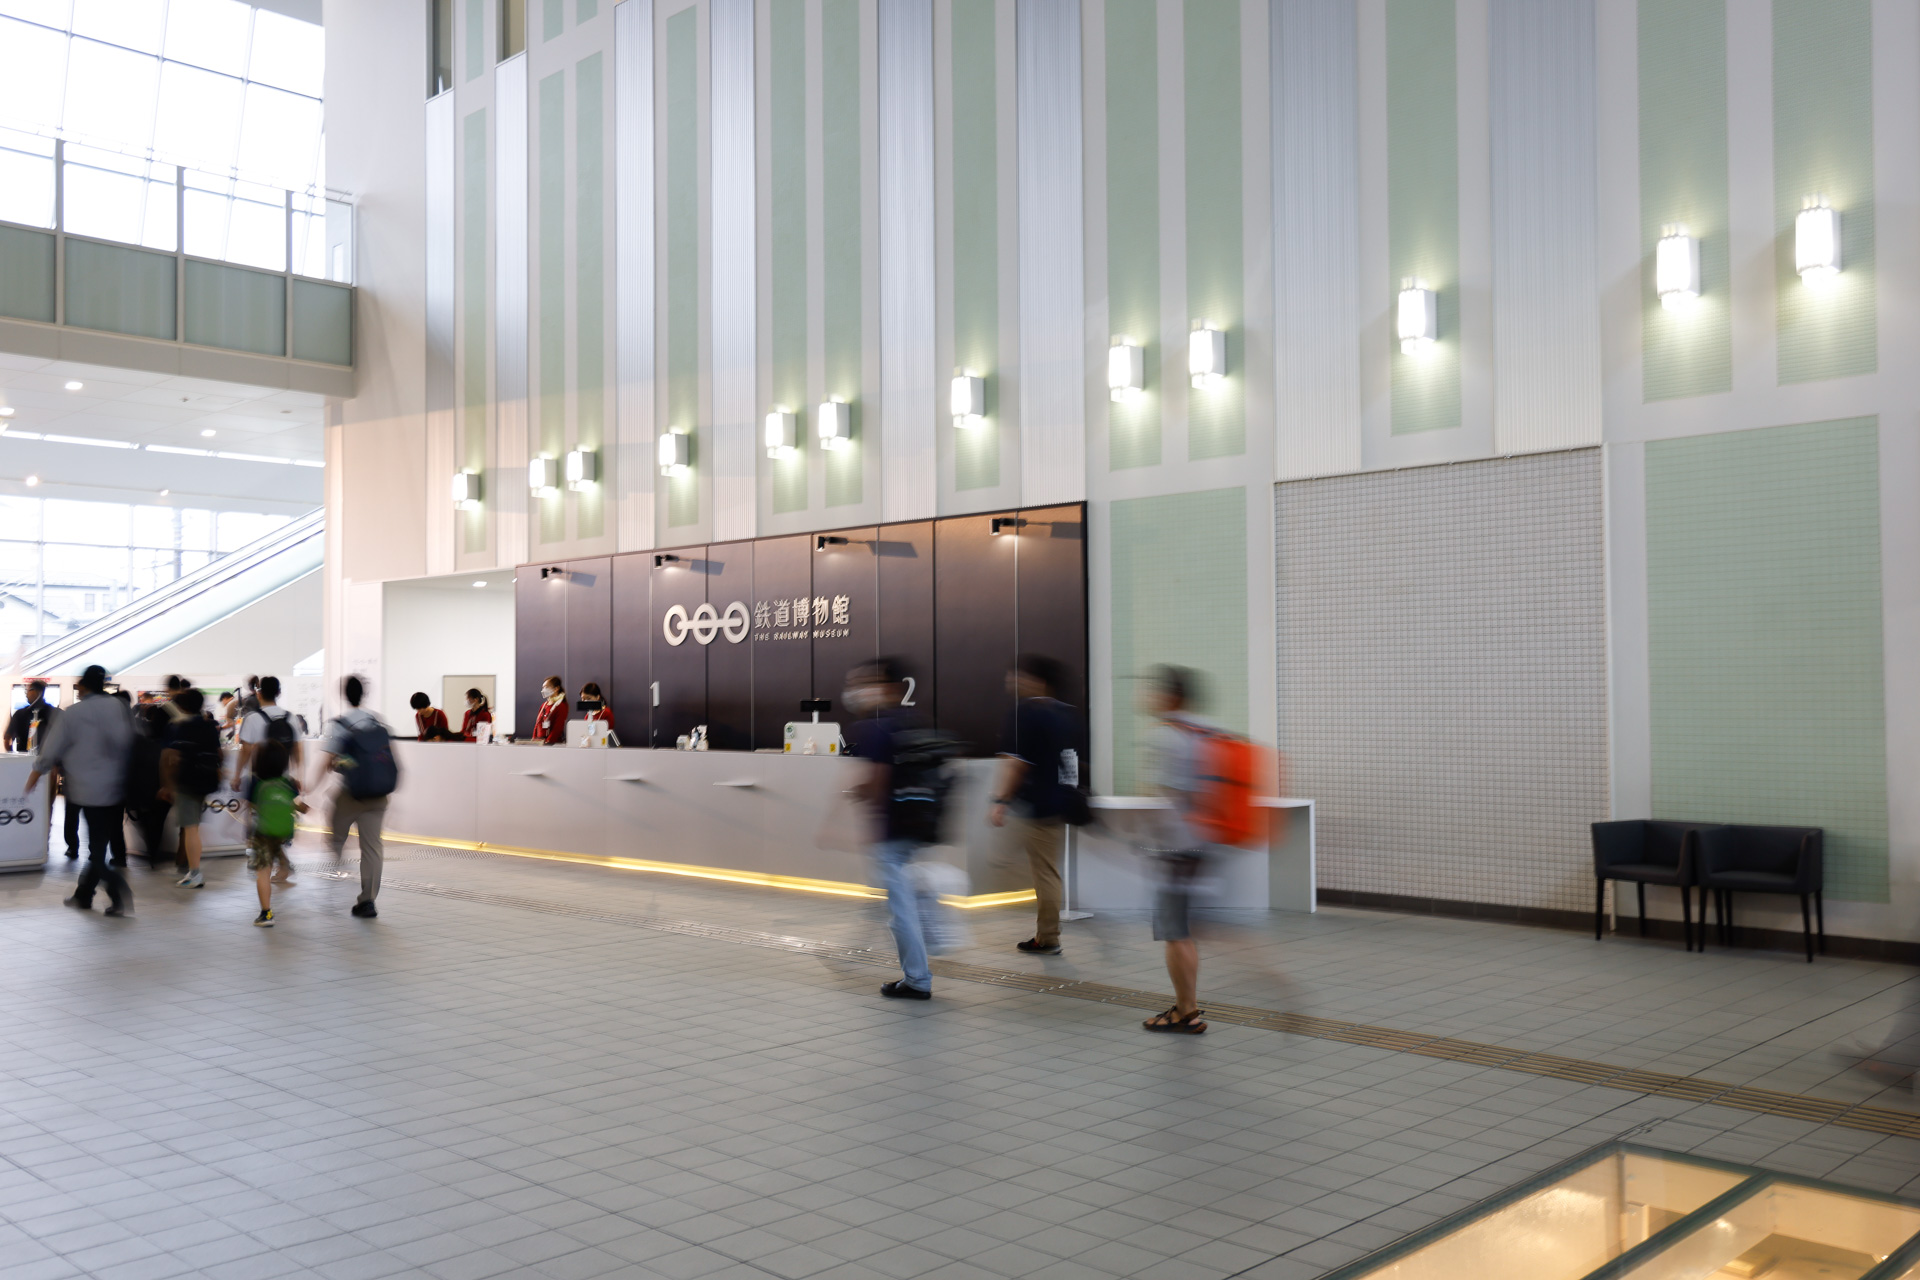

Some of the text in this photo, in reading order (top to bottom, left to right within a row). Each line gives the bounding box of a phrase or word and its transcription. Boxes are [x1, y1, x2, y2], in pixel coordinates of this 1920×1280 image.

[754, 628, 850, 641] THE RAILWAY MUSEUM
[650, 681, 660, 707] 1
[900, 677, 916, 706] 2
